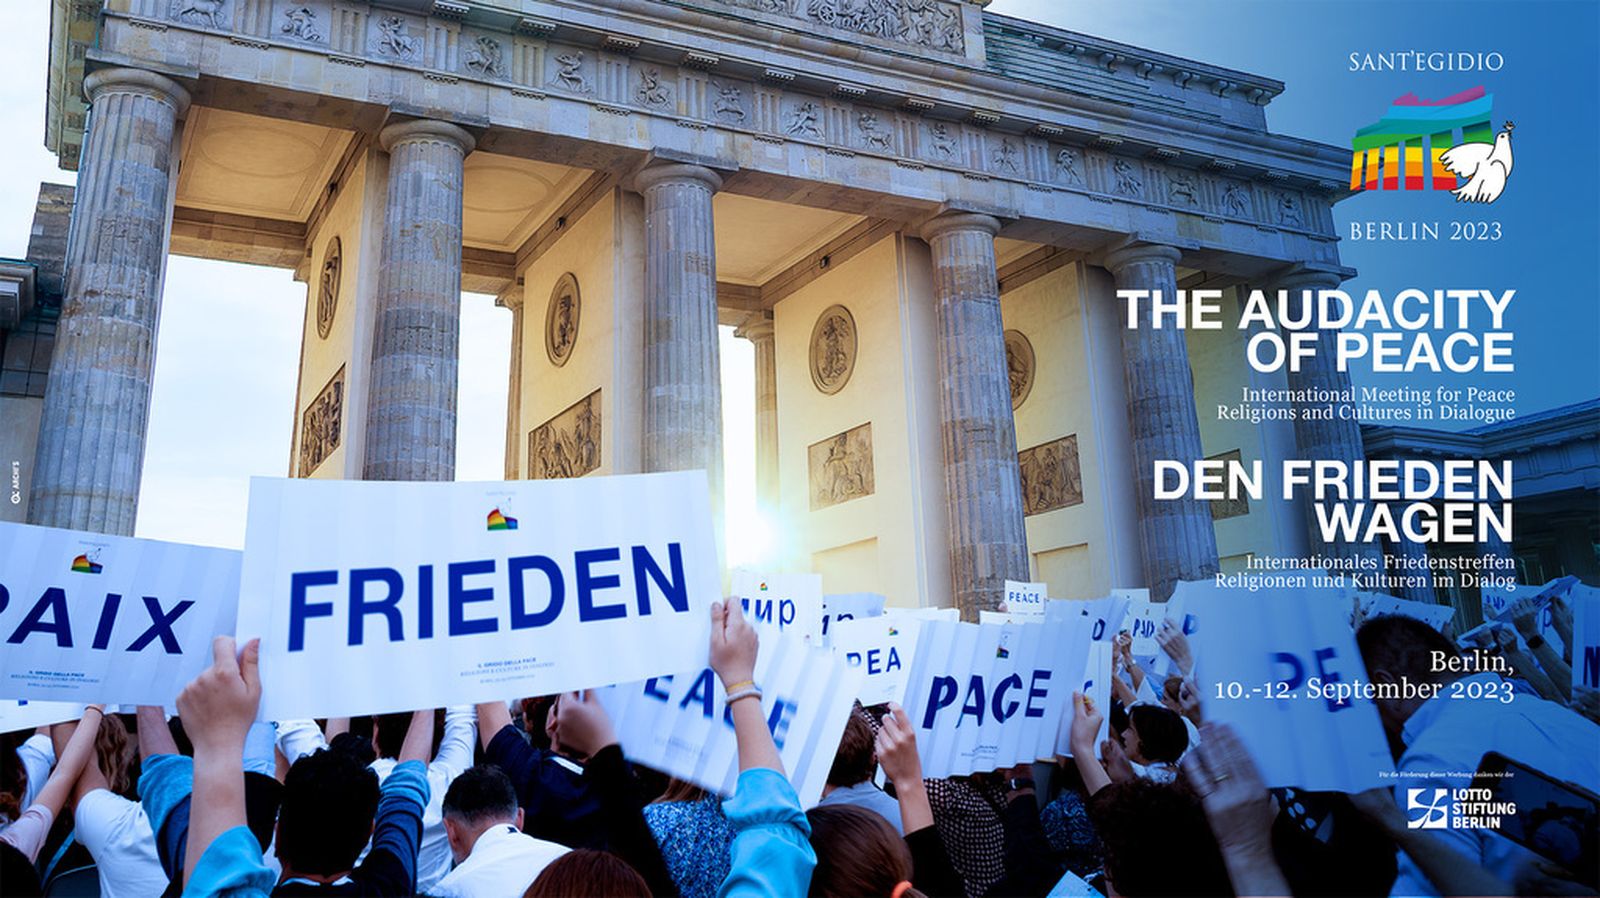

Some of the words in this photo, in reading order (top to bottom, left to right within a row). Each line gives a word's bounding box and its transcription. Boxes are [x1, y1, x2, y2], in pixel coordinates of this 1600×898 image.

[288, 543, 690, 652] FRIEDEN
[1008, 591, 1040, 603] PEACE
[922, 670, 1052, 729] PACE
